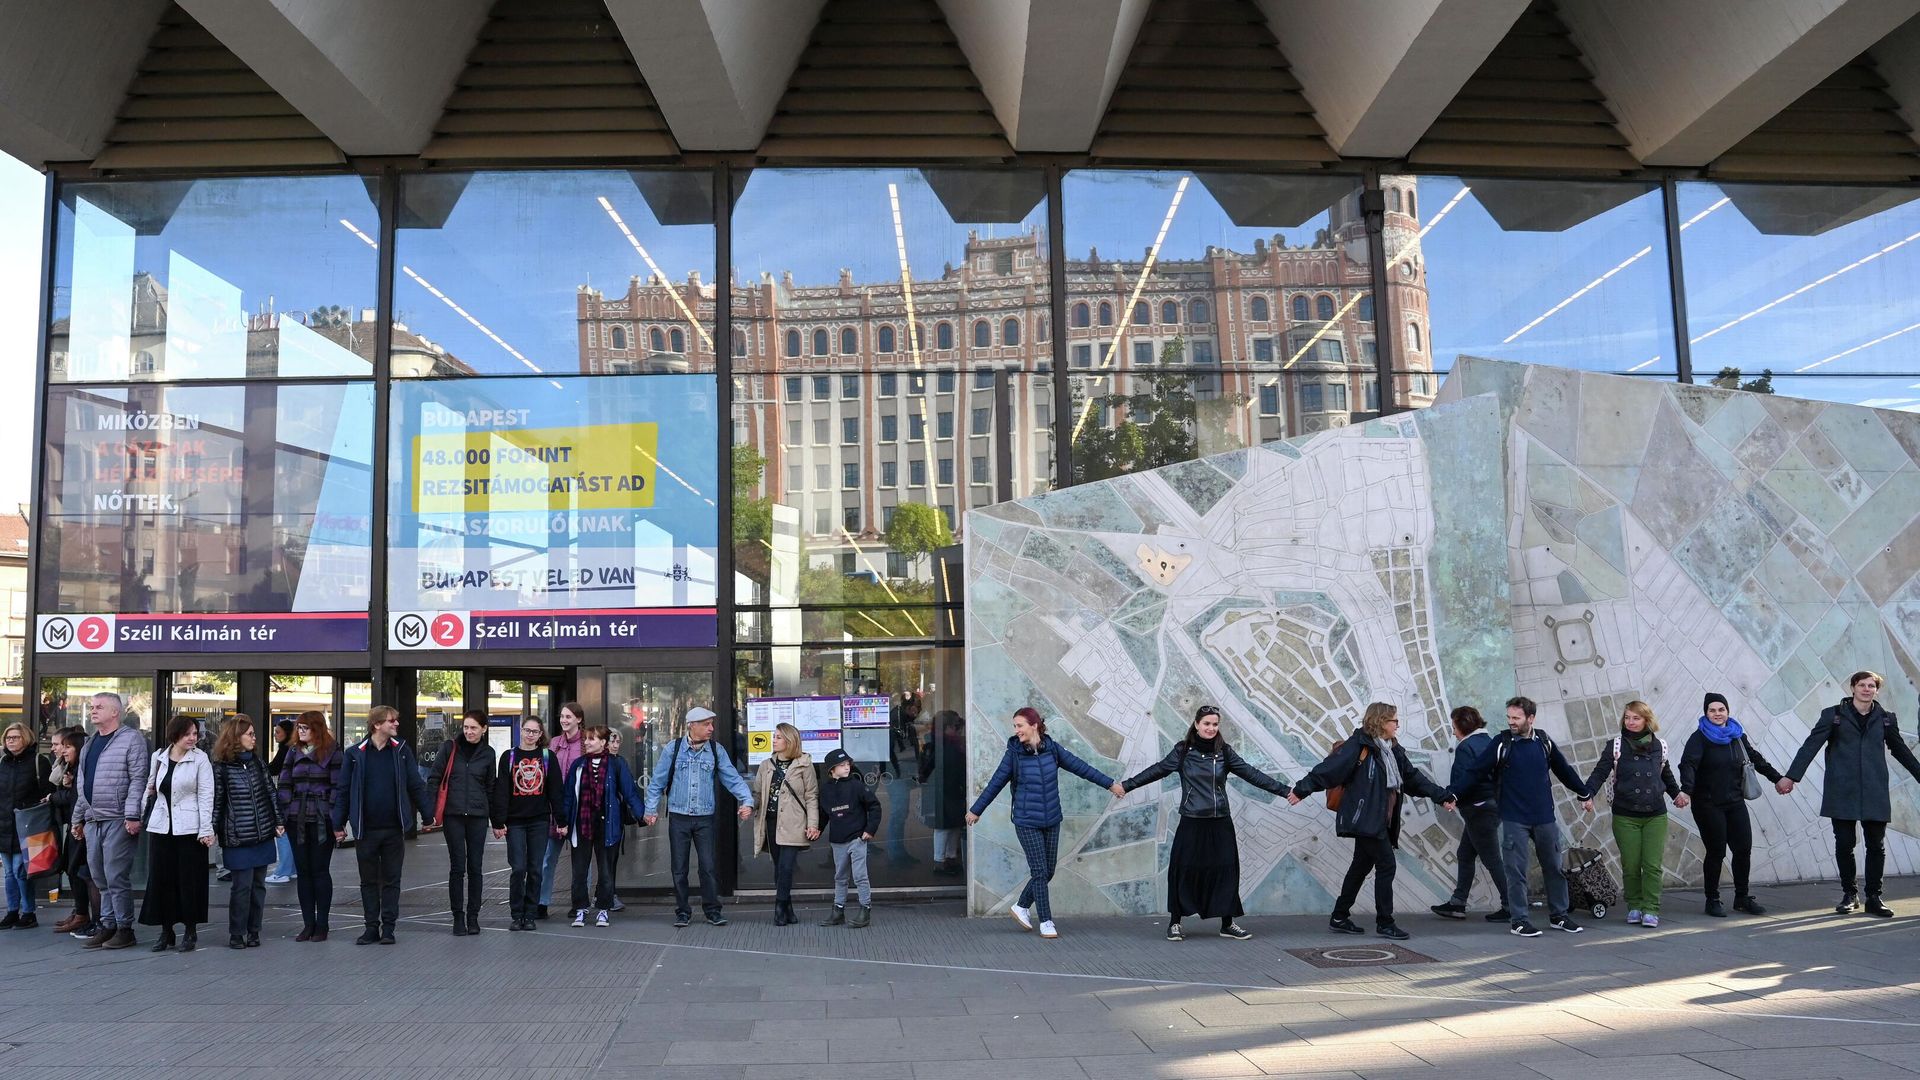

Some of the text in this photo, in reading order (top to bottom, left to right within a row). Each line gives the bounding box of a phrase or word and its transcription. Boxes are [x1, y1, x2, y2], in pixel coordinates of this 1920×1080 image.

[98, 410, 199, 430] MIKÖZBEN
[423, 409, 531, 428] BUDAPEST
[423, 446, 572, 466] 48.000 FORINT
[423, 471, 645, 496] REZSITÁMOGATÁST AD
[94, 489, 180, 514] NŐTTEK,
[423, 512, 632, 537] A RÁSZORULÓKNAK.
[421, 567, 635, 590] BUDAPEST VELED VAN
[86, 624, 99, 643] 2
[120, 625, 277, 641] Széll Kálmán tér
[440, 621, 454, 640] 2
[475, 620, 638, 639] Széll Kálmán tér
